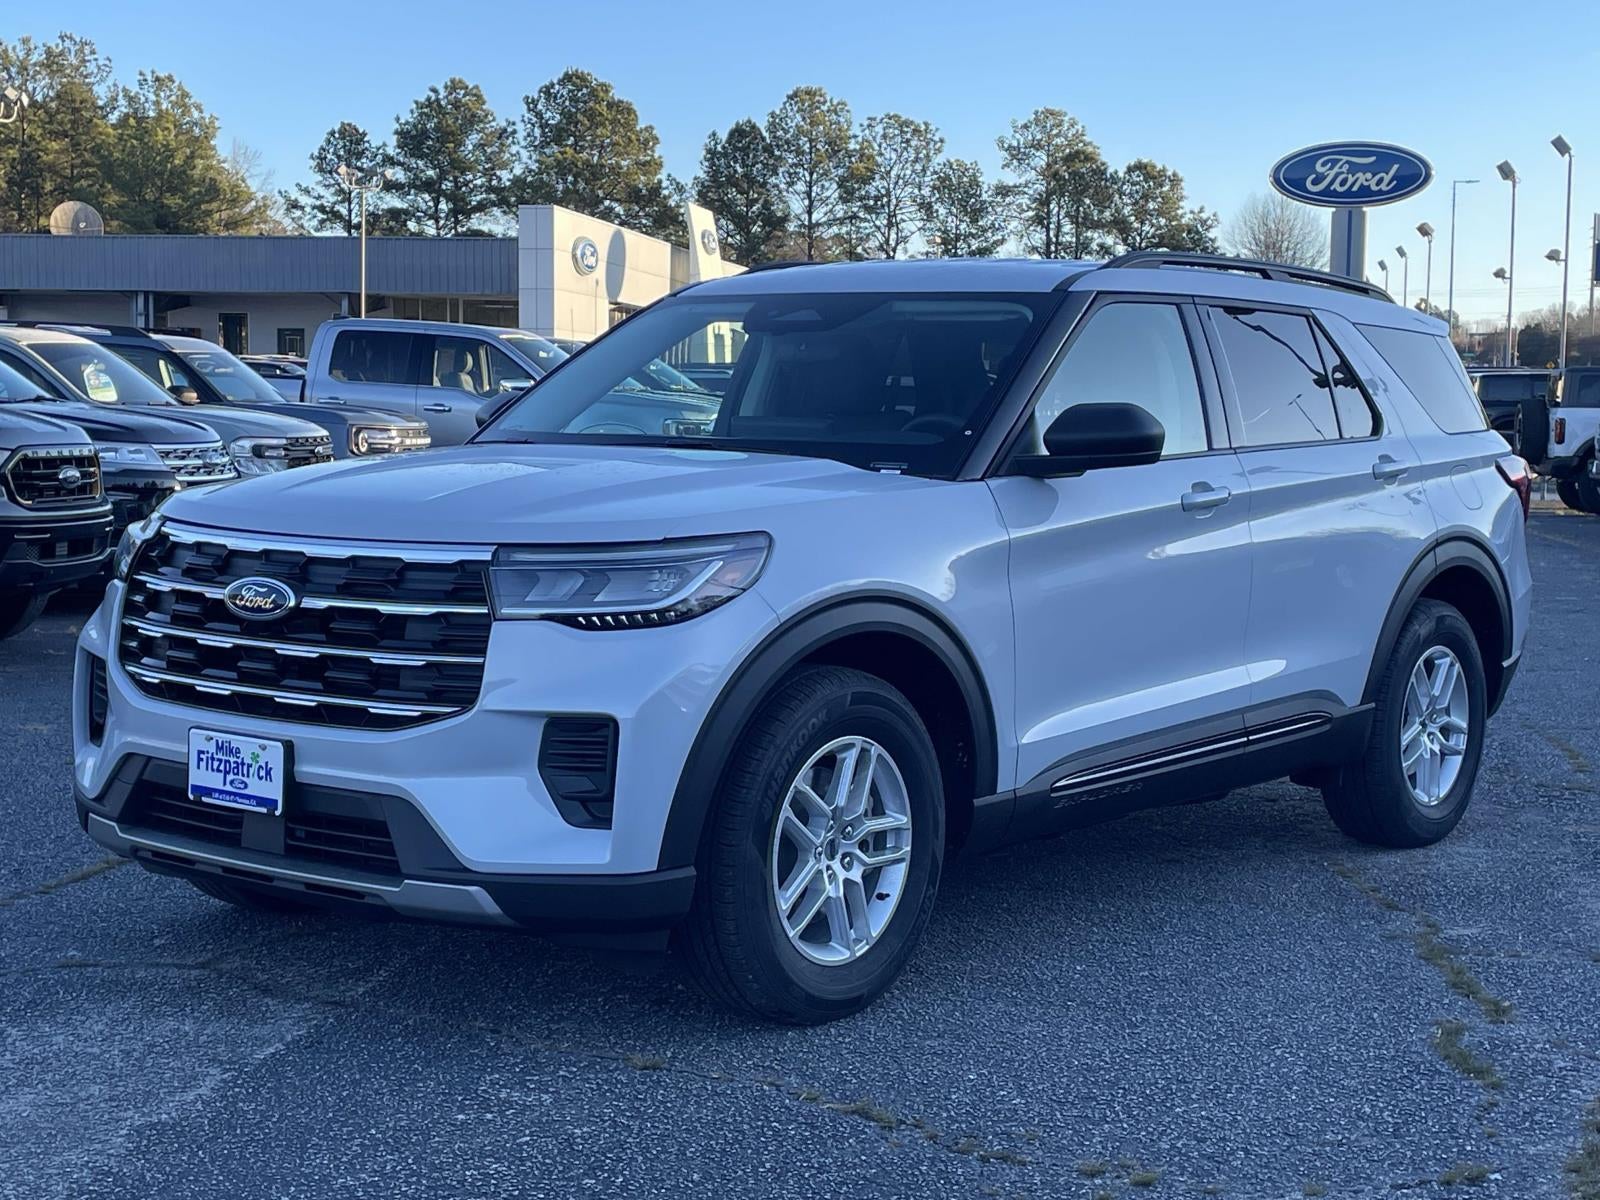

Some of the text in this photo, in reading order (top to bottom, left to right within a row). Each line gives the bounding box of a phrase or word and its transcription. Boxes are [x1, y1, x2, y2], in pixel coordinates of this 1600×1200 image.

[1306, 155, 1399, 192] Ford
[235, 584, 277, 609] Ford
[215, 739, 241, 760] Mike
[197, 749, 273, 788] Fitzpatrick
